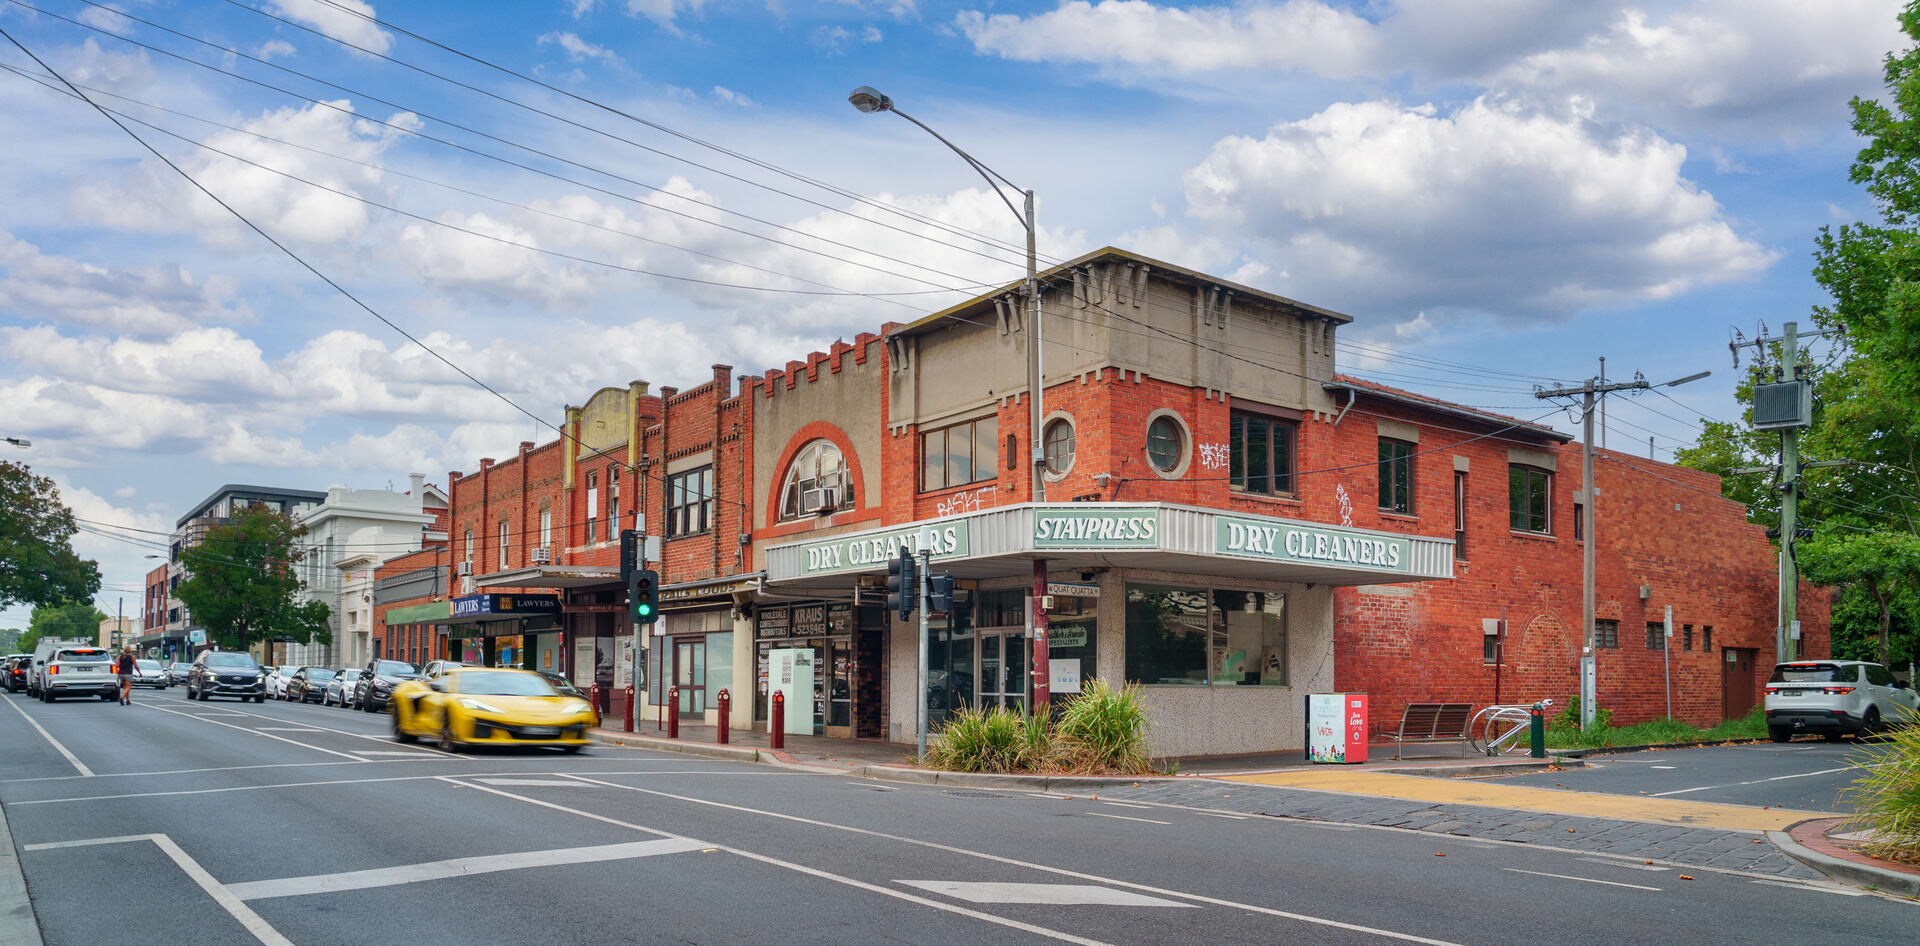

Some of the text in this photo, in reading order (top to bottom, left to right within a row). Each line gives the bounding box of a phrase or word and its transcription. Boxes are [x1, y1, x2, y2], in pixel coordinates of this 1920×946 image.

[1036, 517, 1157, 540] STAYPRESS
[1227, 522, 1400, 568] DRY CLEANERS
[807, 543, 844, 571] DRY
[1053, 585, 1070, 594] QUAT
[1071, 586, 1094, 596] QUATTA
[454, 599, 479, 614] LAWYERS
[517, 600, 554, 609] LAWYERS
[795, 607, 823, 623] KRAUS
[797, 623, 826, 635] 5238463
[835, 620, 845, 630] 62
